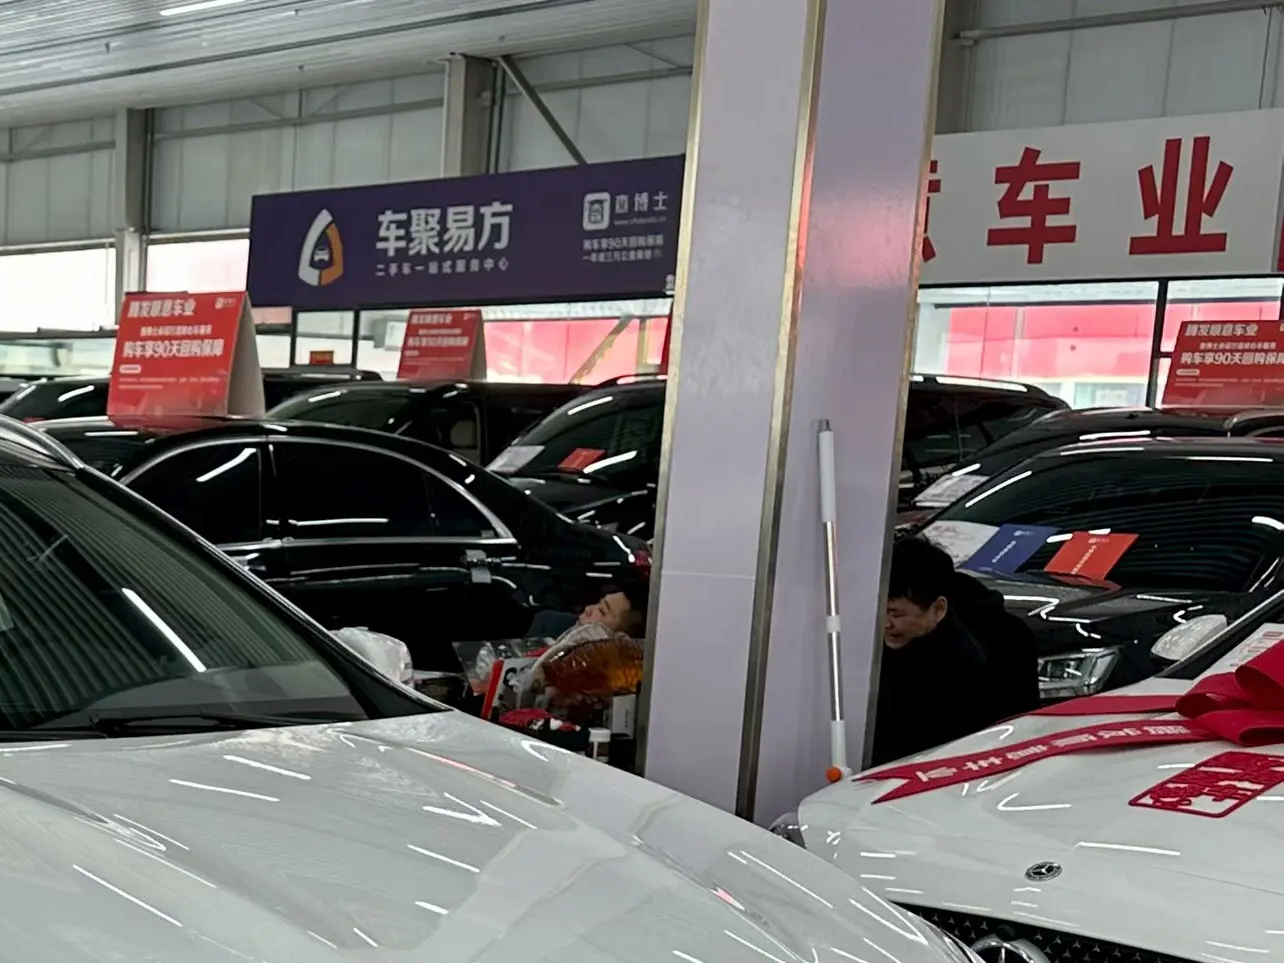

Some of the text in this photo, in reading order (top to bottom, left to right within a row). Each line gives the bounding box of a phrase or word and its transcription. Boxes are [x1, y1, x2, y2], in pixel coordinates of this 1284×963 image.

[375, 201, 514, 257] 车聚易方
[921, 136, 1234, 264] 车业
